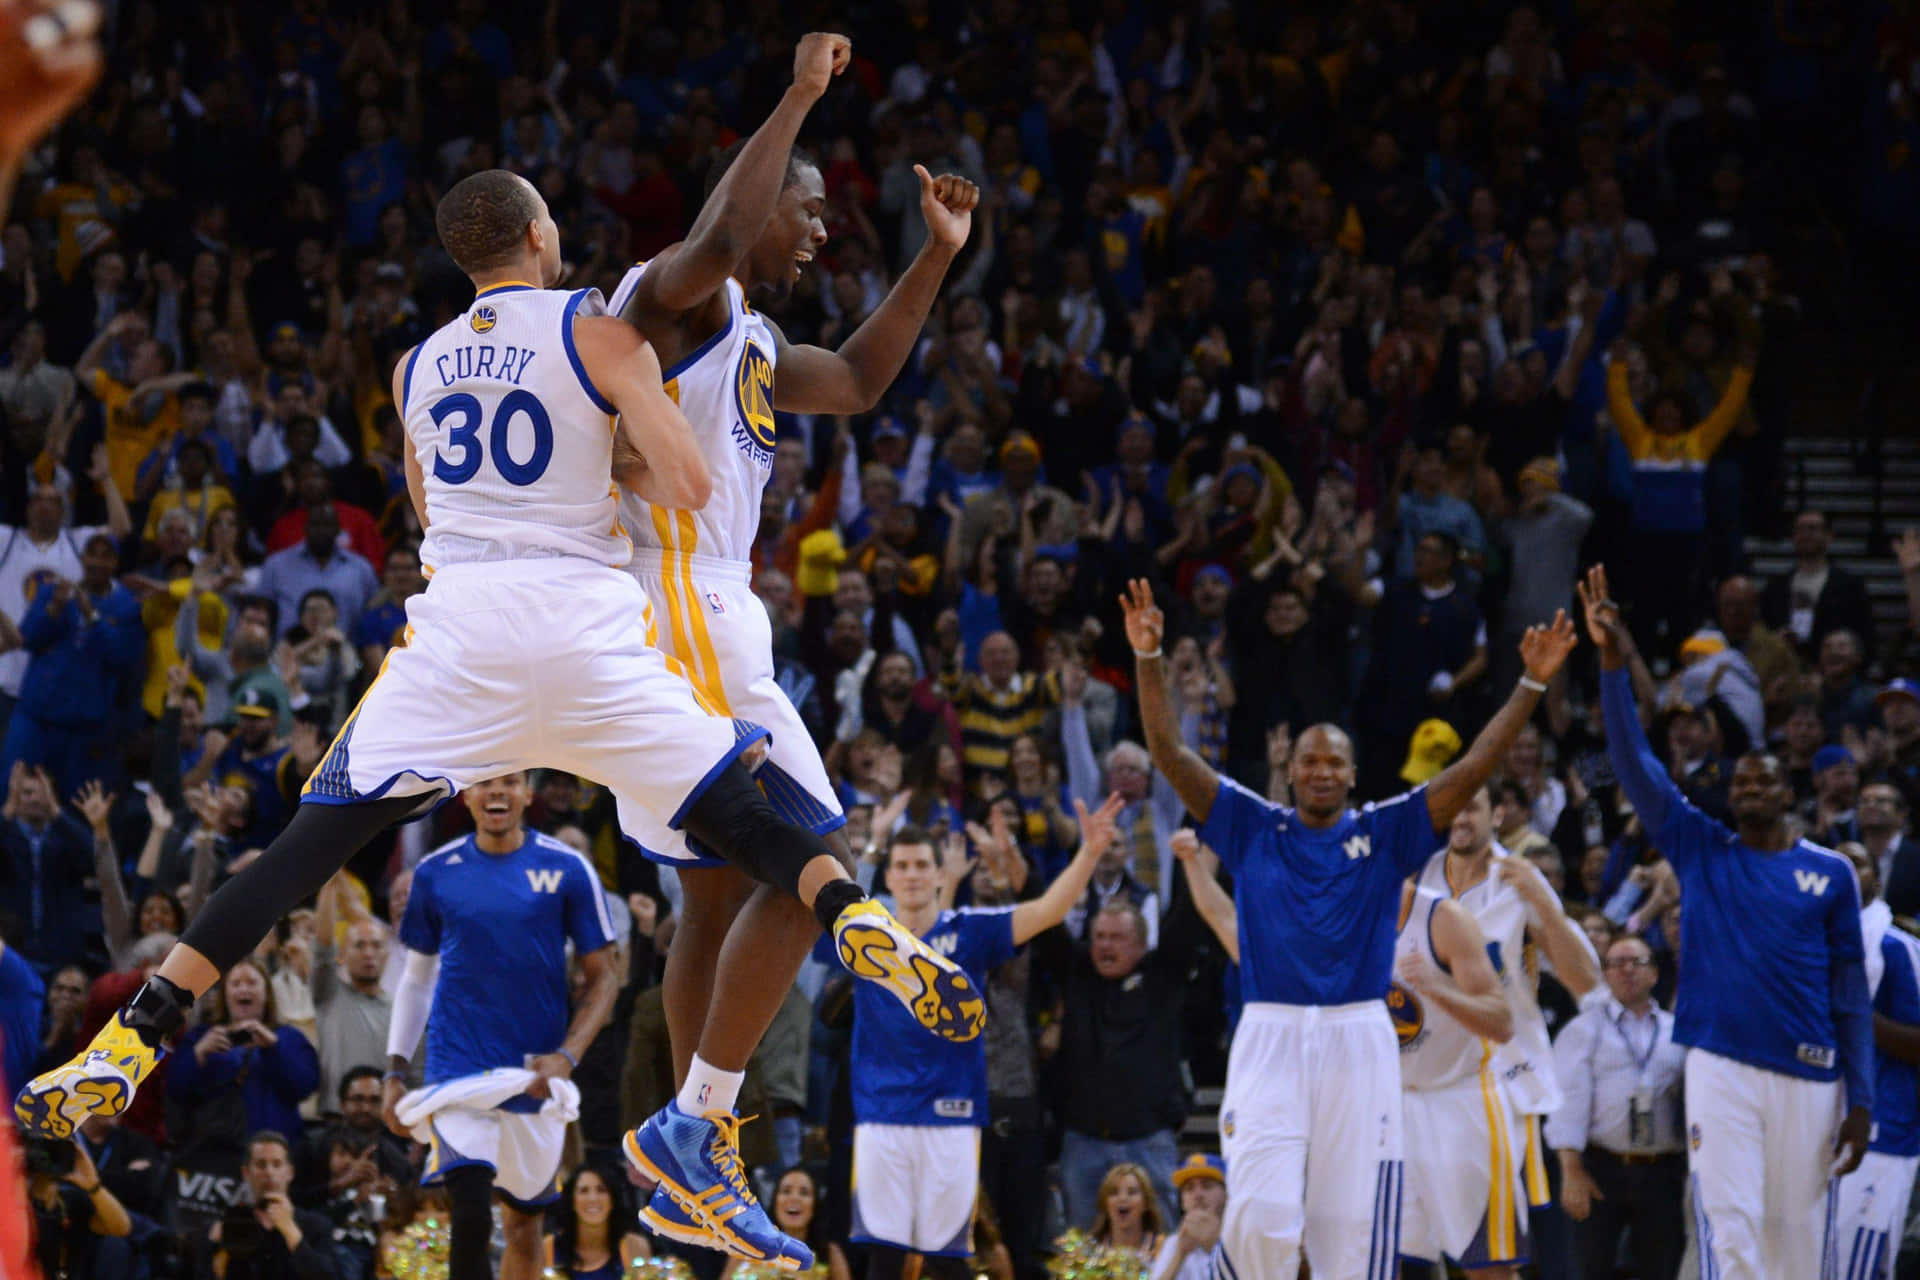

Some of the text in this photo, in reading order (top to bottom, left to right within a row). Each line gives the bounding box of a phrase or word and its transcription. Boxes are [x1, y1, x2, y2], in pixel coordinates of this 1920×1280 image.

[436, 345, 536, 387] CURRY
[428, 389, 554, 486] 30
[731, 421, 774, 470] WARRI
[1343, 835, 1371, 859] W
[525, 868, 563, 893] W
[1793, 869, 1830, 896] W
[178, 1169, 256, 1208] VISA
